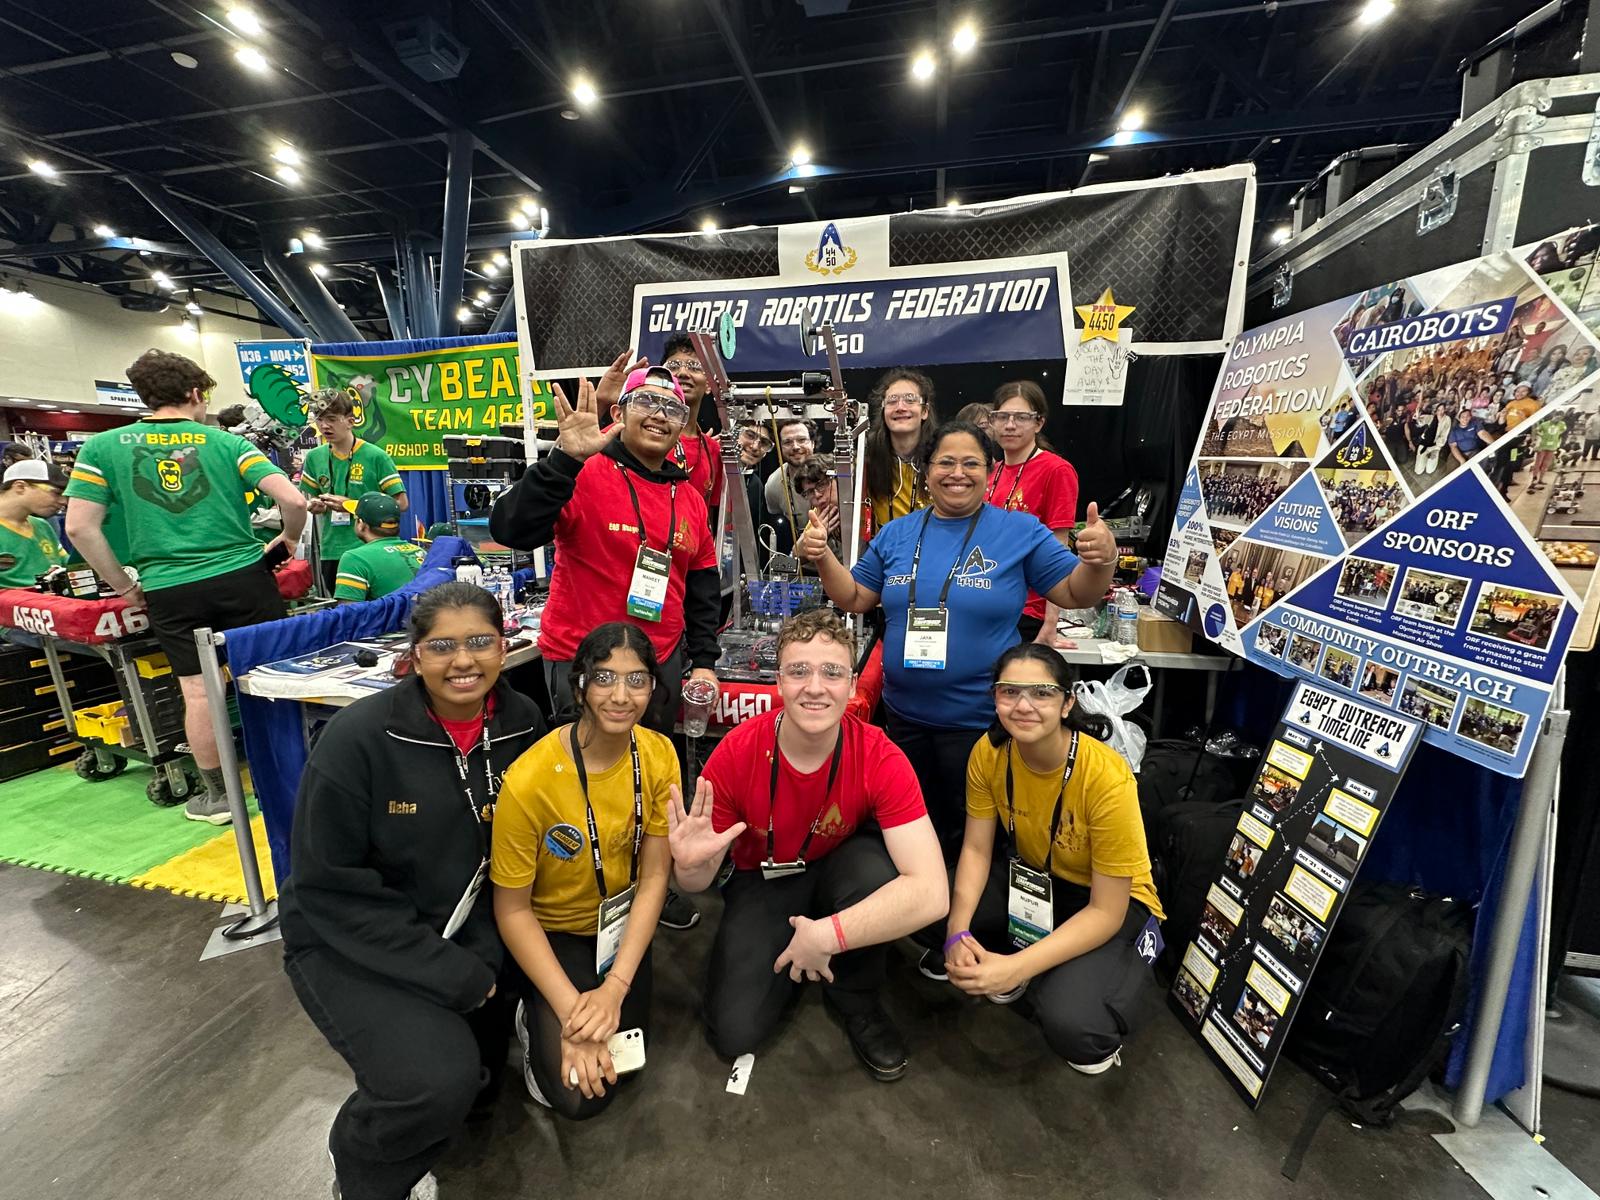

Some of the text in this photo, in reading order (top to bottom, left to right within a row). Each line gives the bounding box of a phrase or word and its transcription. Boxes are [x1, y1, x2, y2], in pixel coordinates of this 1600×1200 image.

[825, 248, 836, 257] 44
[825, 257, 837, 267] 50
[759, 291, 875, 327] ROBOTICS
[885, 277, 1051, 321] FEDERATION
[1092, 304, 1117, 313] PNW
[1088, 312, 1116, 332] 4450
[1349, 304, 1503, 354] CAIROBOTS
[811, 333, 865, 356] 450
[1233, 320, 1305, 361] OLYMPIA
[240, 351, 262, 363] M36
[270, 350, 292, 362] M04
[1087, 355, 1105, 364] THE
[1084, 365, 1105, 375] DAY
[1222, 353, 1310, 391] ROBOTICS
[385, 356, 554, 404] CYBEA
[1214, 386, 1328, 421] FEDERATION
[410, 407, 474, 432] TEAM
[119, 432, 207, 446] CYBEARS
[1211, 431, 1225, 441] THE
[1227, 430, 1255, 441] EGYPT
[385, 443, 430, 458] BISHOP
[1277, 502, 1323, 519] FUTURE
[1426, 508, 1478, 532] ORF
[1187, 520, 1204, 532] 100%
[1274, 515, 1319, 534] VISIONS
[1383, 530, 1515, 568] SPONSORS
[886, 574, 912, 587] ORF
[956, 576, 992, 590] 4450
[12, 605, 58, 637] 4682
[1402, 618, 1418, 627] team
[1418, 621, 1436, 633] booth
[1444, 628, 1455, 637] the
[1398, 624, 1441, 642] Olympic Flight
[1425, 639, 1444, 649] Show
[1465, 635, 1481, 645] ORF
[1480, 640, 1516, 655] receiving
[1522, 652, 1547, 664] grant
[1279, 610, 1517, 705] COMMUNITY OUTREACH
[1463, 642, 1545, 670] from Amazon to start
[1485, 657, 1500, 667] FLL
[1500, 661, 1523, 673] team.
[1300, 688, 1407, 743] EGYPT OUTREACH
[1317, 713, 1373, 750] TIMELINE
[1349, 783, 1362, 793] AUG
